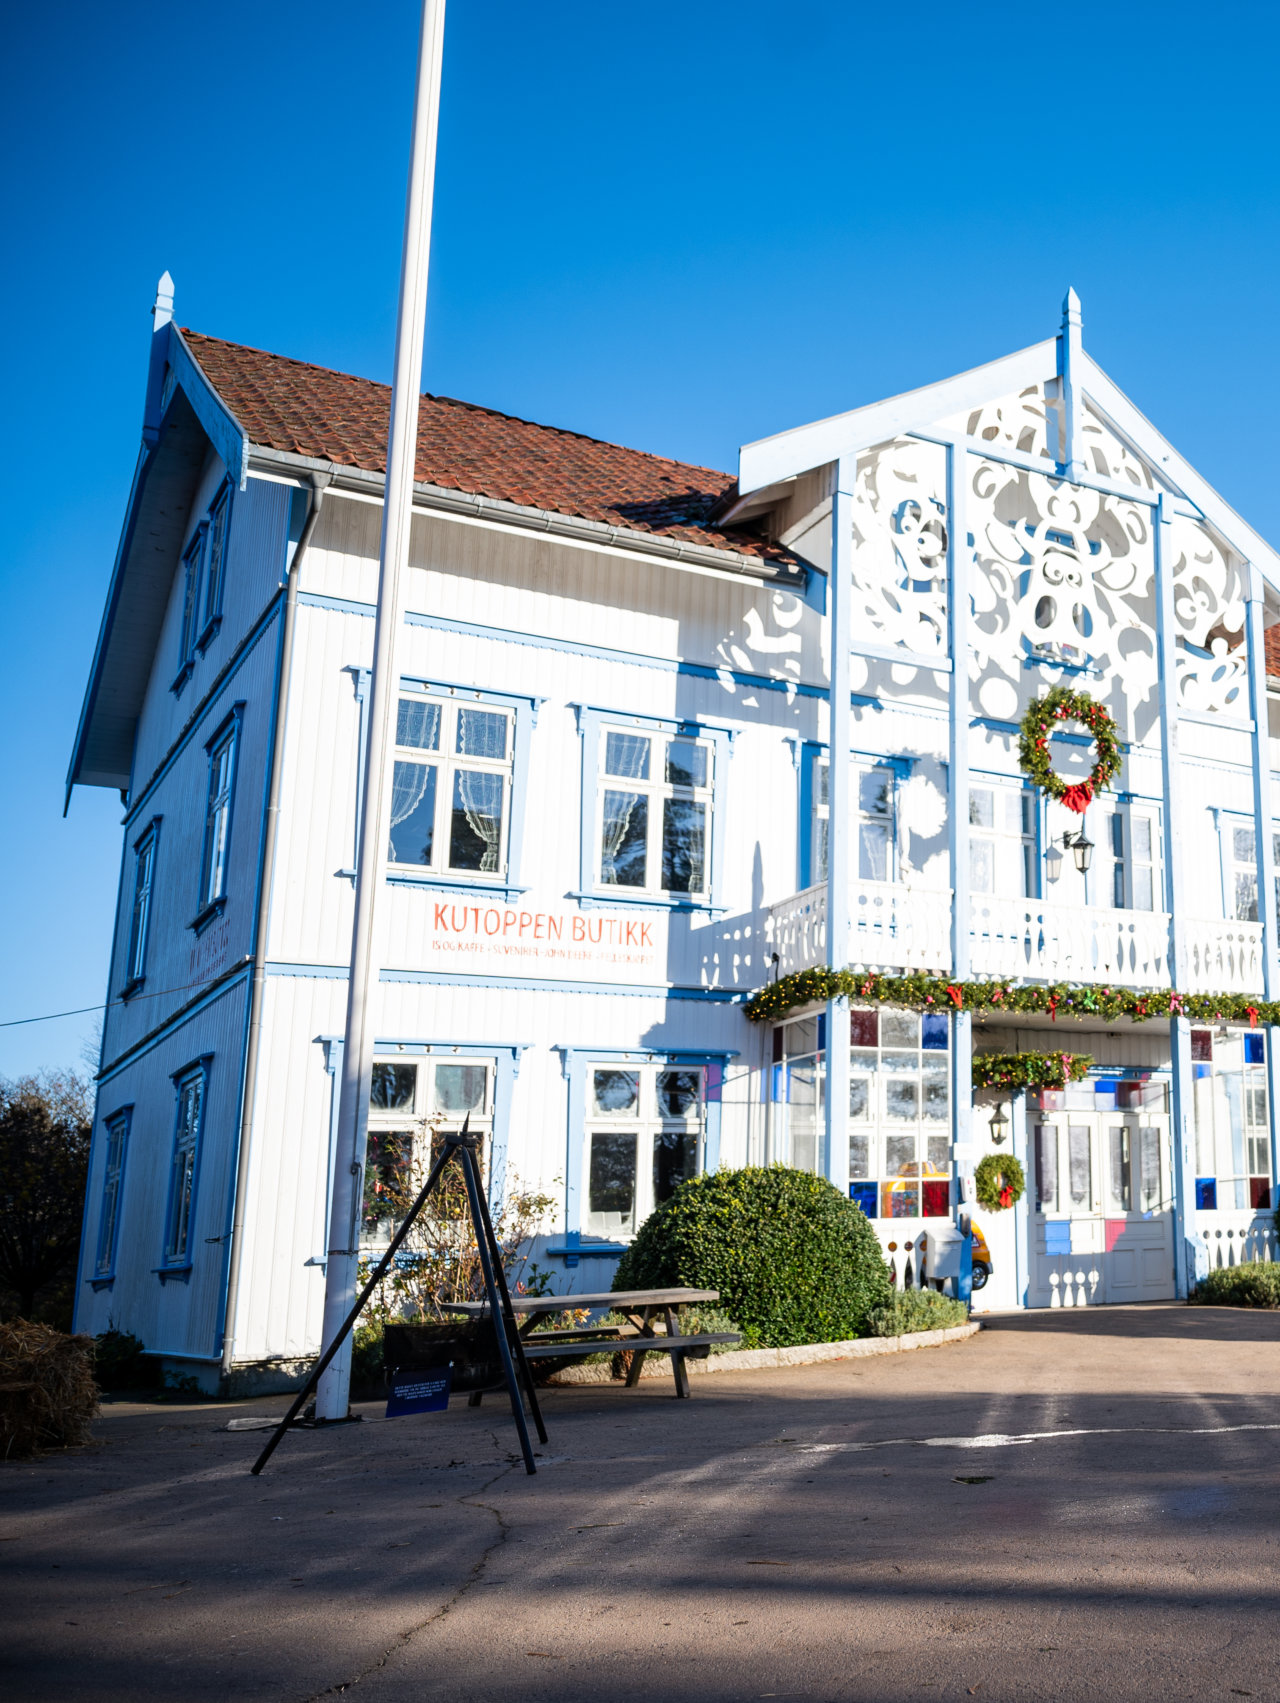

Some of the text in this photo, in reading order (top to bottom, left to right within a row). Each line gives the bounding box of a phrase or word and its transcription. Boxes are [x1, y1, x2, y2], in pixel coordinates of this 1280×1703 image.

[434, 903, 654, 947] KUTOPPEN BUTIKK
[432, 940, 441, 950] IS
[442, 941, 455, 952] OG
[457, 941, 484, 953] KAFFE
